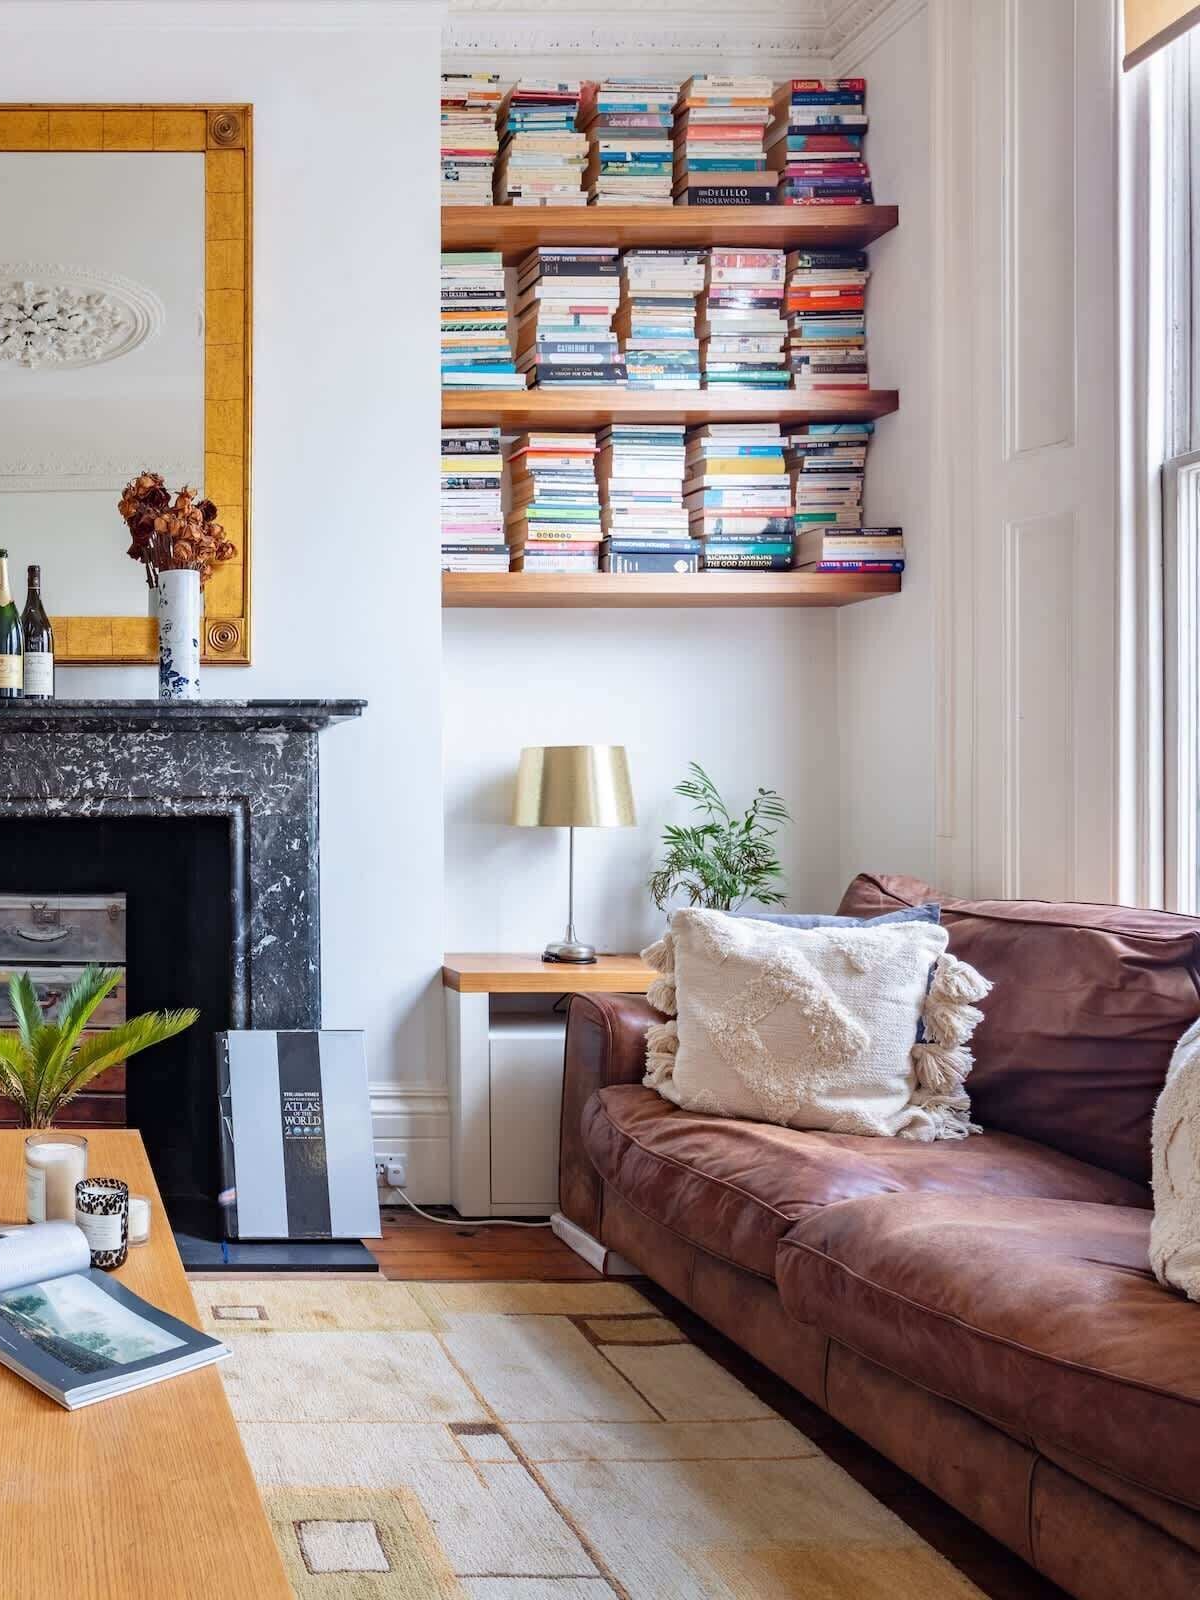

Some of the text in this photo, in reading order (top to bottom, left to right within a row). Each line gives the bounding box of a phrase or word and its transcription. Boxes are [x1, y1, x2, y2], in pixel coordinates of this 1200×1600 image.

[557, 344, 587, 353] CATHERINE
[284, 1102, 320, 1111] ATLAS
[284, 1116, 321, 1125] WORLD
